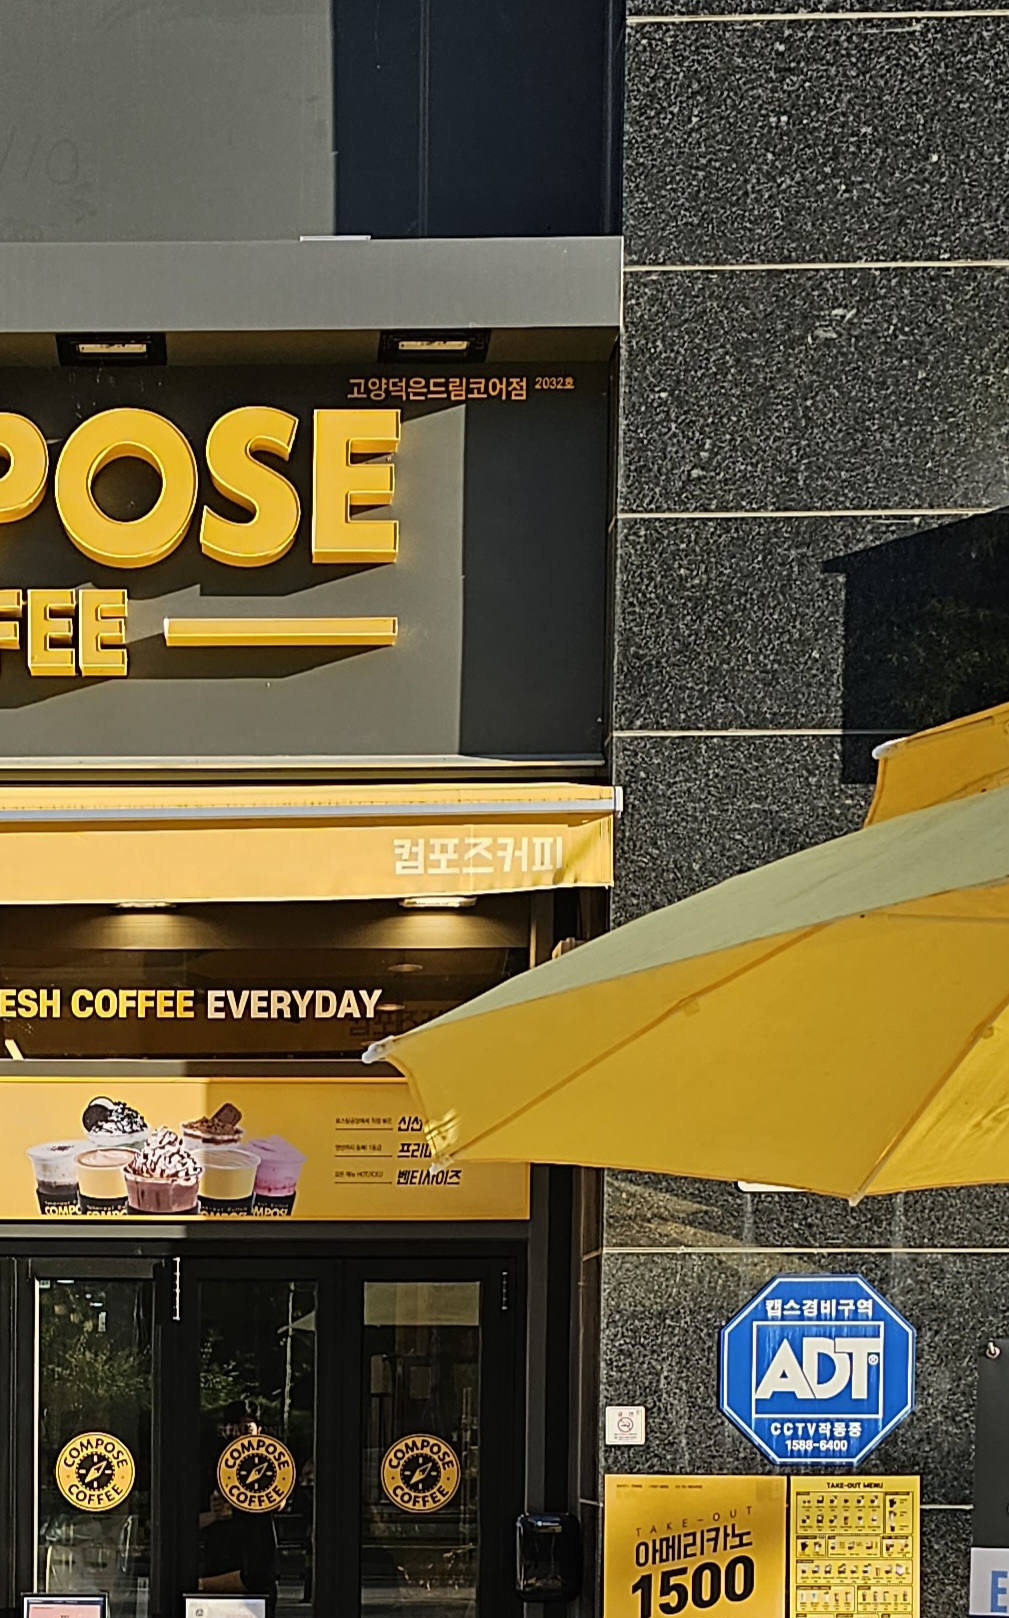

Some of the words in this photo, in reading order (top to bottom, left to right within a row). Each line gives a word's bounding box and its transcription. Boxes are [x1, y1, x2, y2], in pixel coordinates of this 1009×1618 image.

[347, 376, 528, 401] 고양덕은드림코어점
[534, 376, 575, 391] 2032호
[393, 835, 564, 875] 컴포즈커피
[70, 988, 196, 1019] COFFEE
[205, 988, 383, 1019] EVERYDAY
[765, 1298, 873, 1317] 캡스경비구역
[755, 1337, 881, 1400] ADT
[771, 1422, 862, 1438] CCTV작동중
[64, 1439, 129, 1468] COMPOSE
[224, 1439, 290, 1470] COMPOSE
[388, 1440, 454, 1470] COMPOSE
[785, 1439, 848, 1451] 1588-6400
[67, 1483, 123, 1505] COFFEE
[228, 1484, 285, 1507] COFFEE
[392, 1484, 450, 1507] COFFEE
[636, 1505, 753, 1537] TAKE-OUT
[635, 1523, 753, 1568] 아메리카노
